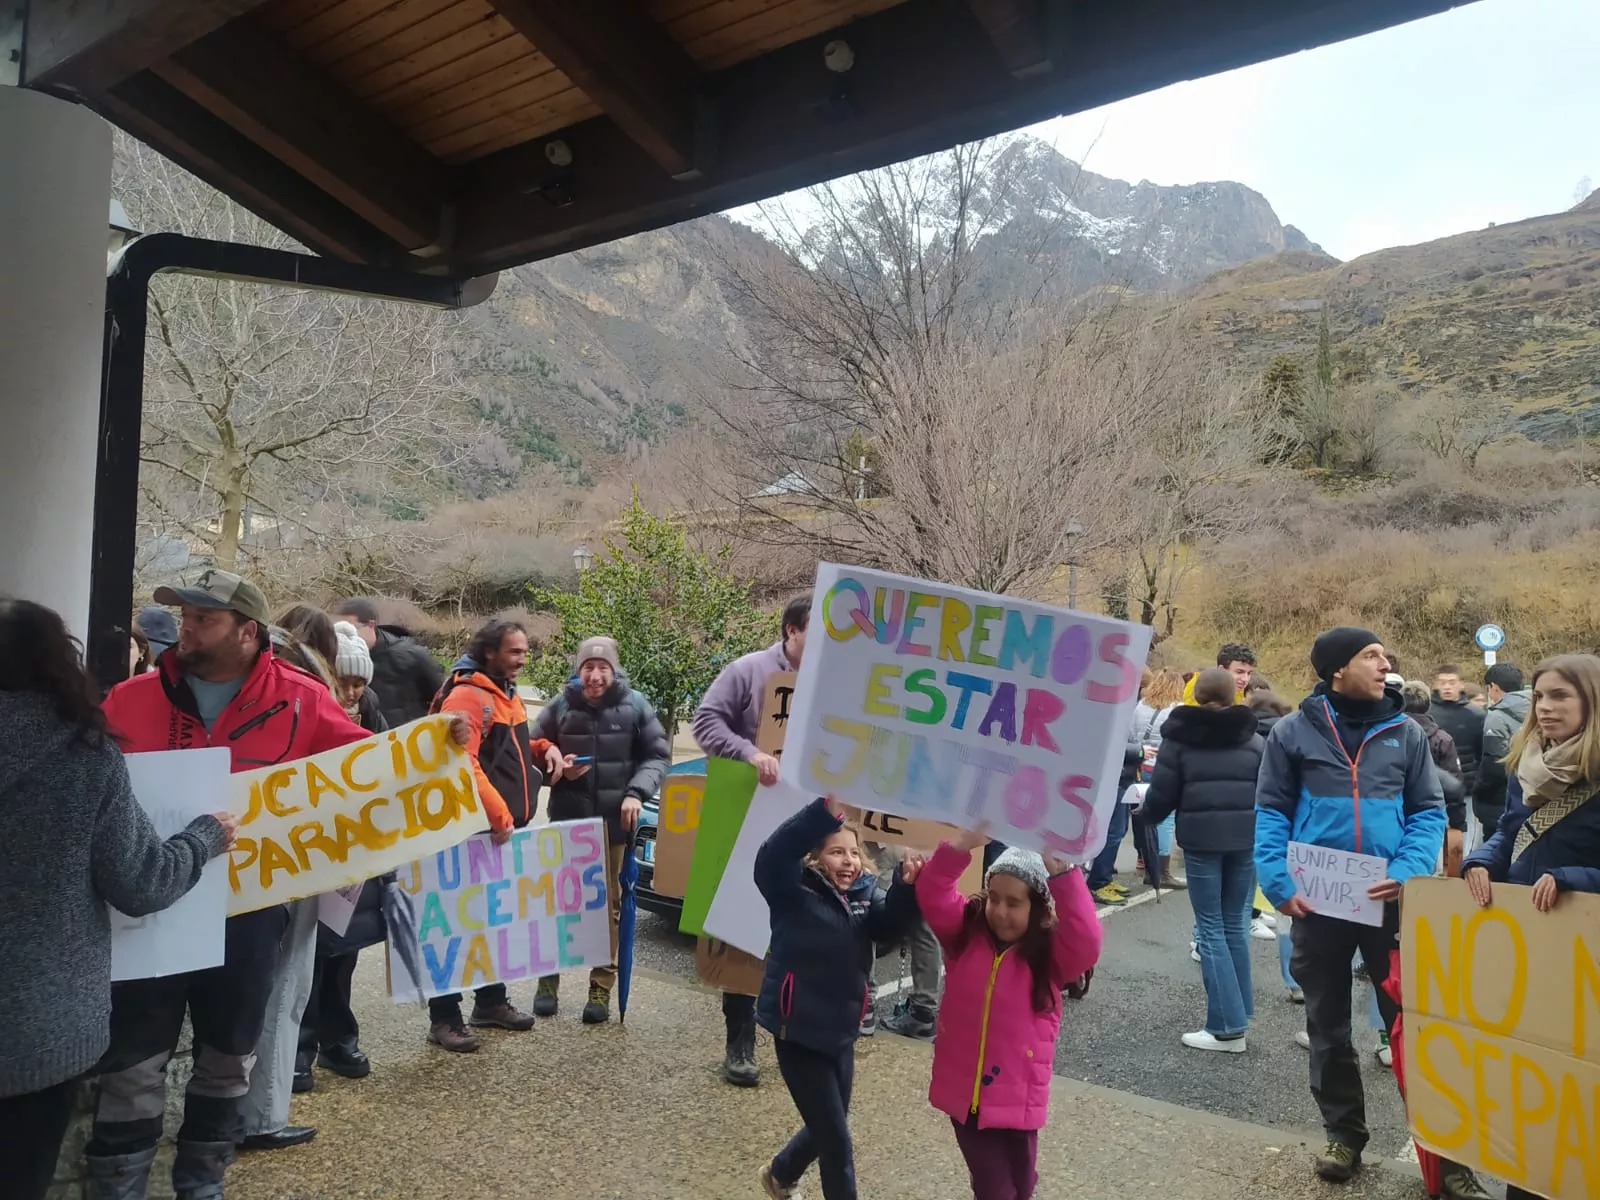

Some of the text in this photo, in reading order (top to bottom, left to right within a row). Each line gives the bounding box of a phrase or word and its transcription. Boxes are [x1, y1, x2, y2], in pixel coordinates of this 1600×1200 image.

[821, 577, 1136, 704] QUEREMOS
[863, 662, 1062, 755] ESTAR
[228, 767, 477, 895] PARACION
[811, 714, 1099, 856] JUNTOS
[399, 824, 600, 895] JUNTOS
[418, 864, 607, 942] ACEMOS
[1295, 846, 1372, 879] UNIR ES
[1299, 873, 1356, 907] VIVIR
[422, 913, 584, 992] VALLE
[1415, 907, 1528, 1038] NO
[1415, 1021, 1600, 1200] SEPA
